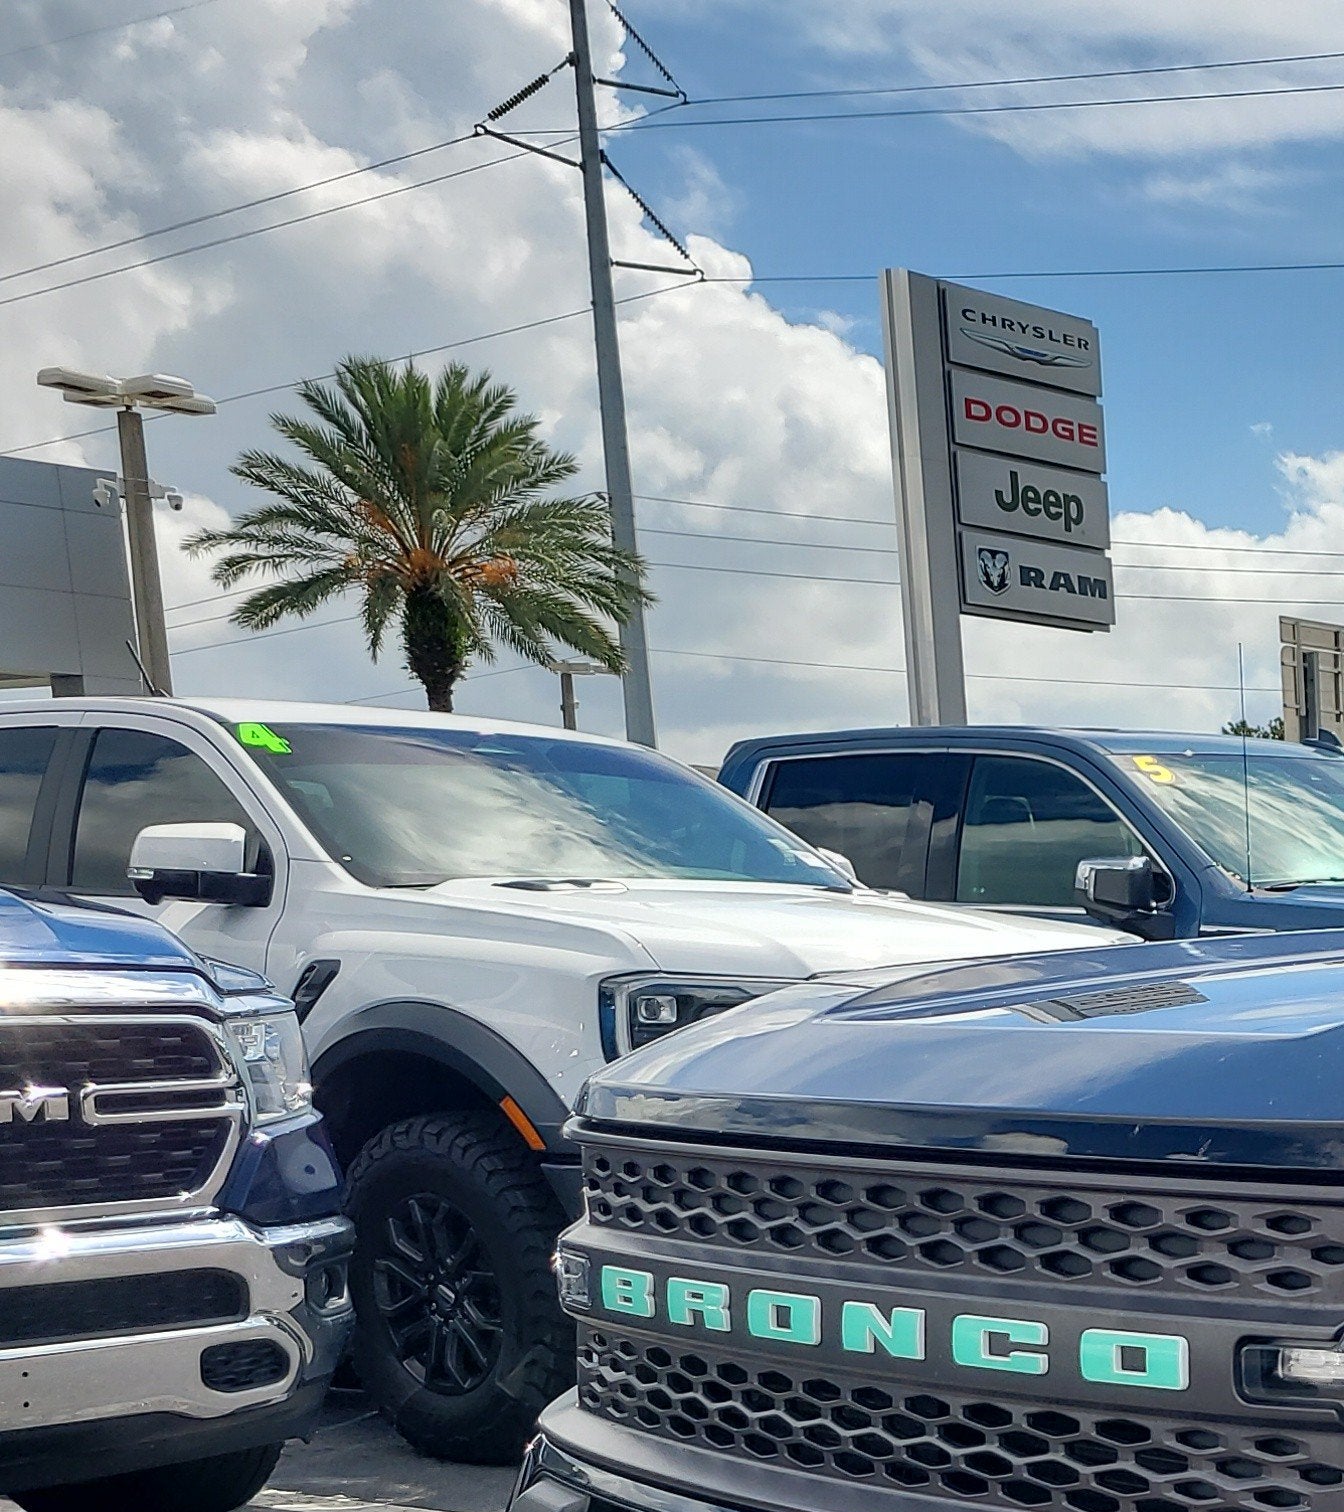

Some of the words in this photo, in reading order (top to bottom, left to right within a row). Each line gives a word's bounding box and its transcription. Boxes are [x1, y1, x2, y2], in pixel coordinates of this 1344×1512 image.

[961, 308, 1090, 351] CHRYSLER
[964, 397, 1099, 447] DODGE
[994, 470, 1085, 533] Jeep
[1019, 564, 1108, 600] RAM
[237, 722, 292, 754] 4
[1132, 755, 1176, 785] 5
[600, 1263, 1191, 1392] BRONCO
